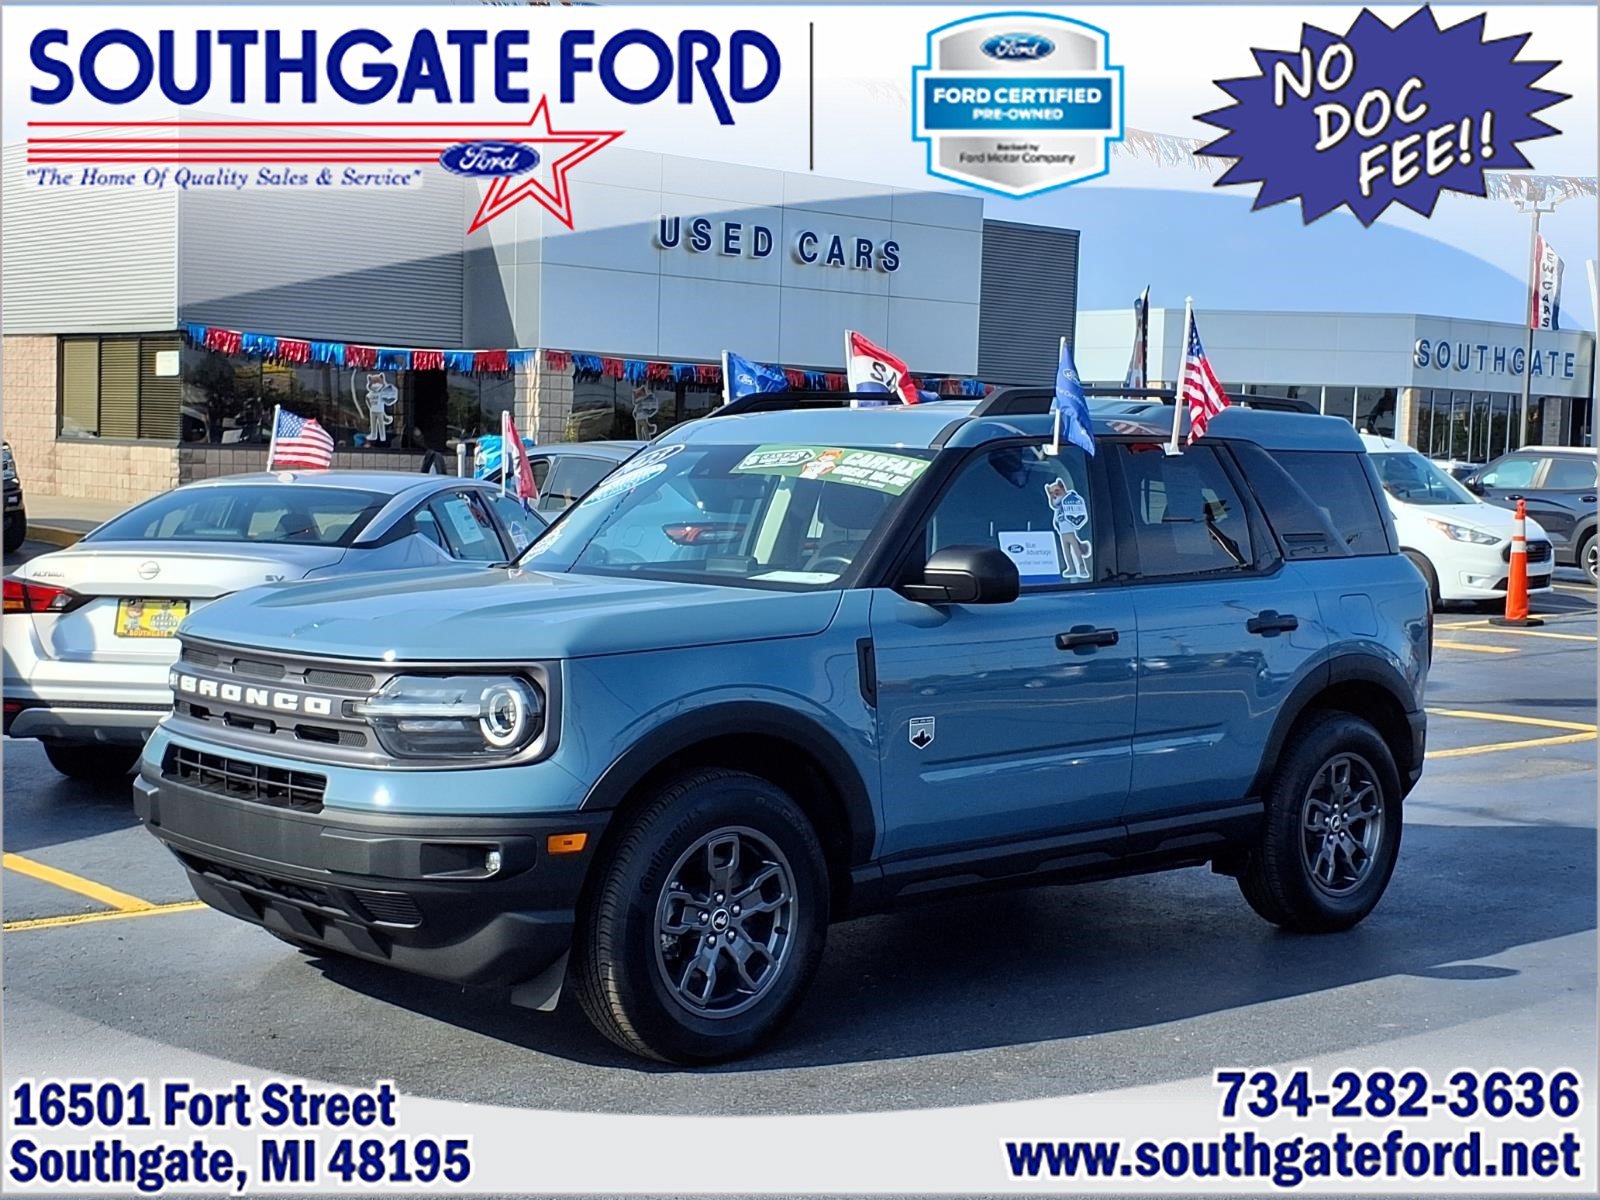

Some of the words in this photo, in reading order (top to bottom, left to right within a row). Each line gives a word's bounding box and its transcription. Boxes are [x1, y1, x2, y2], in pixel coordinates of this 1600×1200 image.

[659, 214, 774, 258] USED
[797, 231, 901, 272] CARS
[1541, 281, 1553, 328] CARS
[1415, 338, 1575, 378] SOUTHGATE
[842, 452, 926, 477] CARFAX
[180, 674, 332, 715] BRONCO
